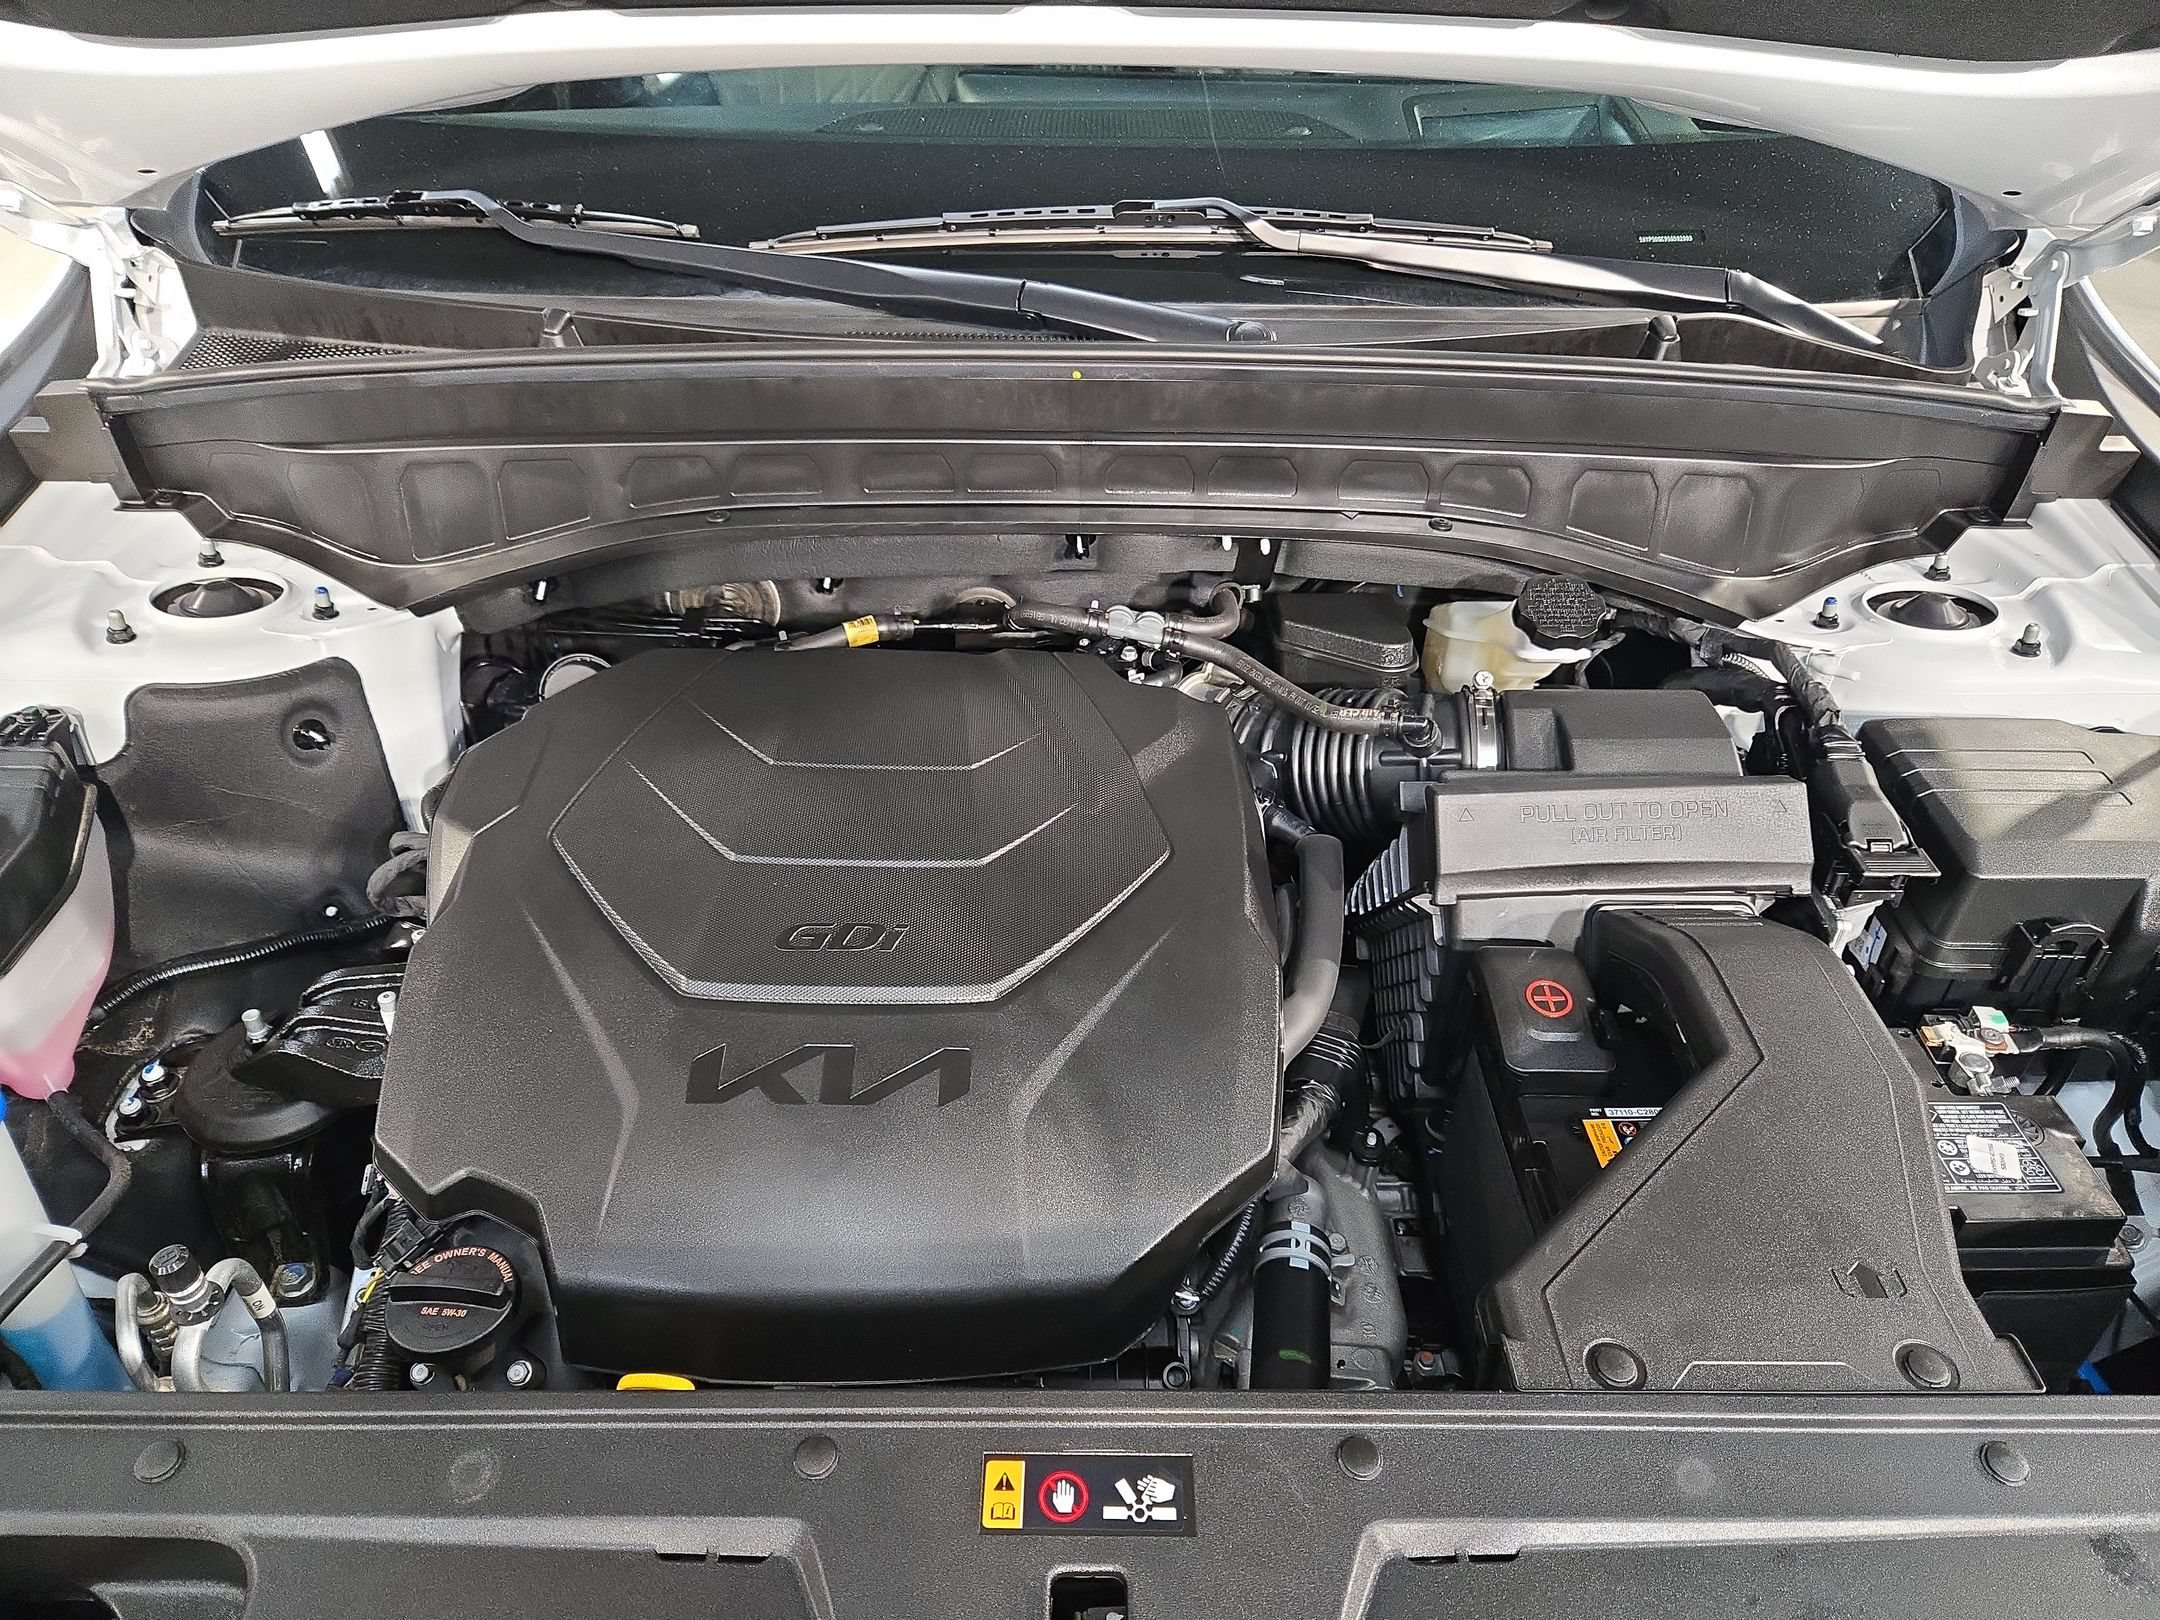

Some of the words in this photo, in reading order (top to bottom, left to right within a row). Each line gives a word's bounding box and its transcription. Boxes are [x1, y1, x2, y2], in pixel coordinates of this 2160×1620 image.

[1519, 803, 1576, 824] PULL
[1583, 802, 1628, 822] OUT
[1634, 801, 1663, 820] TO
[1670, 800, 1729, 819] OPEN
[1570, 826, 1608, 844] (AIR
[1614, 824, 1683, 842] FILTER)
[434, 1247, 487, 1263] OWNER'S
[420, 1306, 440, 1316] SAE
[441, 1308, 468, 1318] 5W-30
